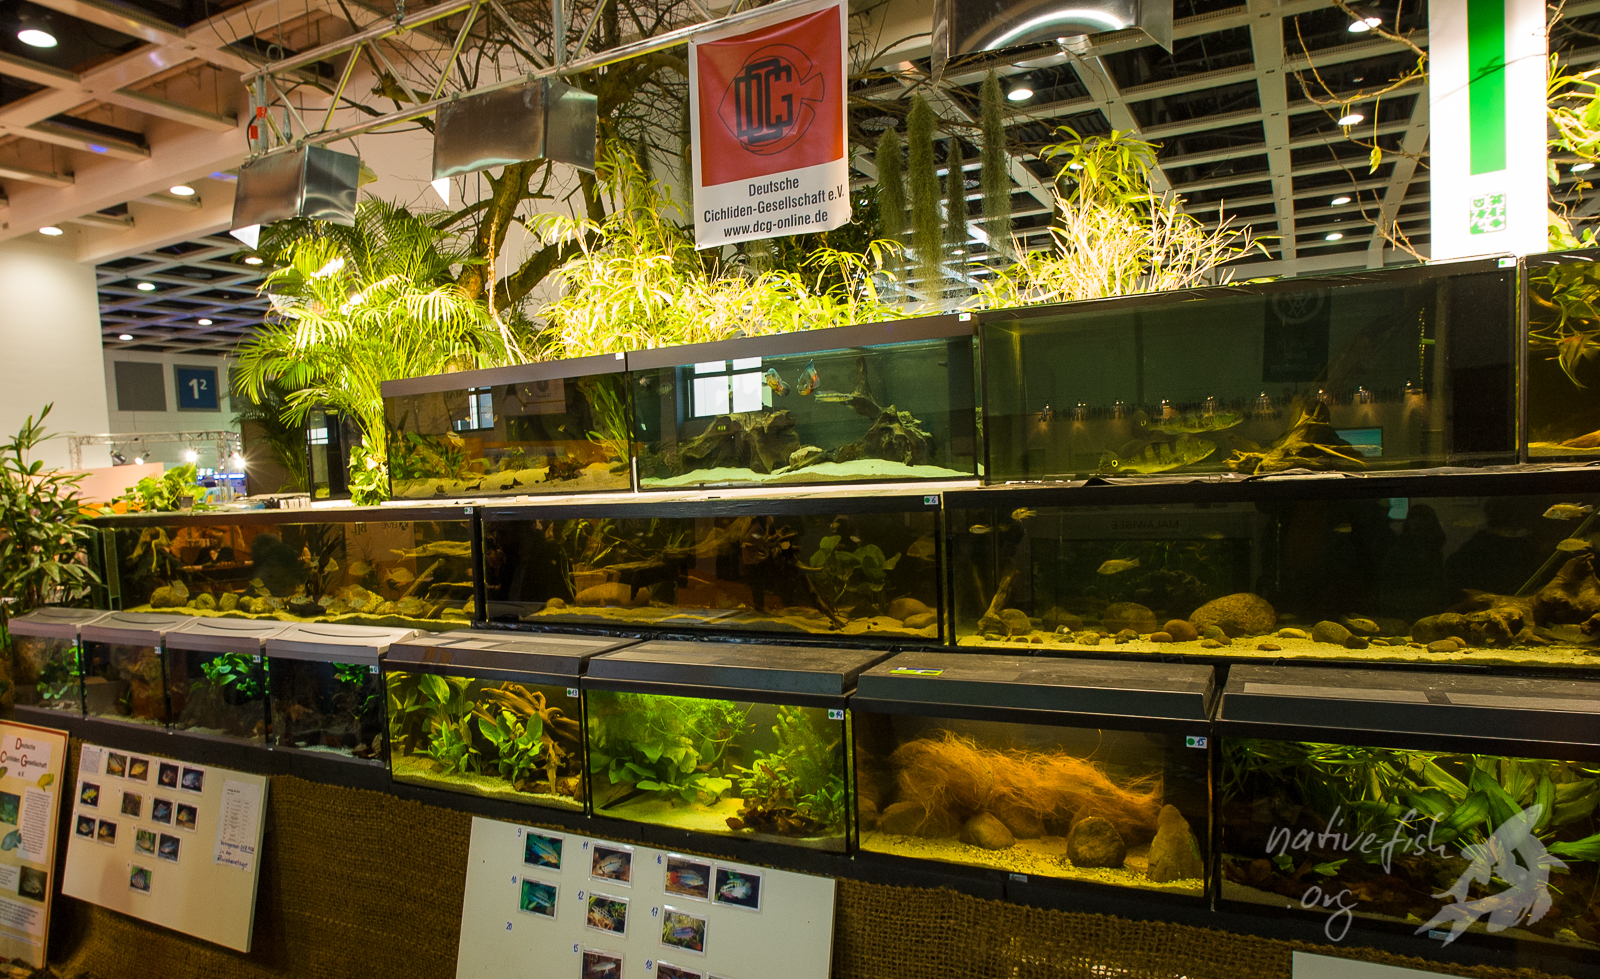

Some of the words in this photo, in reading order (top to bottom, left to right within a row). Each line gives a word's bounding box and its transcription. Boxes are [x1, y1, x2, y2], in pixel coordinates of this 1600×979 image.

[748, 177, 799, 197] Deutsche
[704, 191, 826, 223] Cichliden-Gesellschaft
[828, 184, 845, 201] e.V.
[1470, 207, 1505, 221] ZZF
[723, 209, 829, 238] www.dcg-online.de
[517, 828, 522, 838] 9
[578, 890, 584, 900] 12
[651, 906, 658, 917] 17
[506, 921, 513, 931] 20
[573, 943, 579, 953] 15
